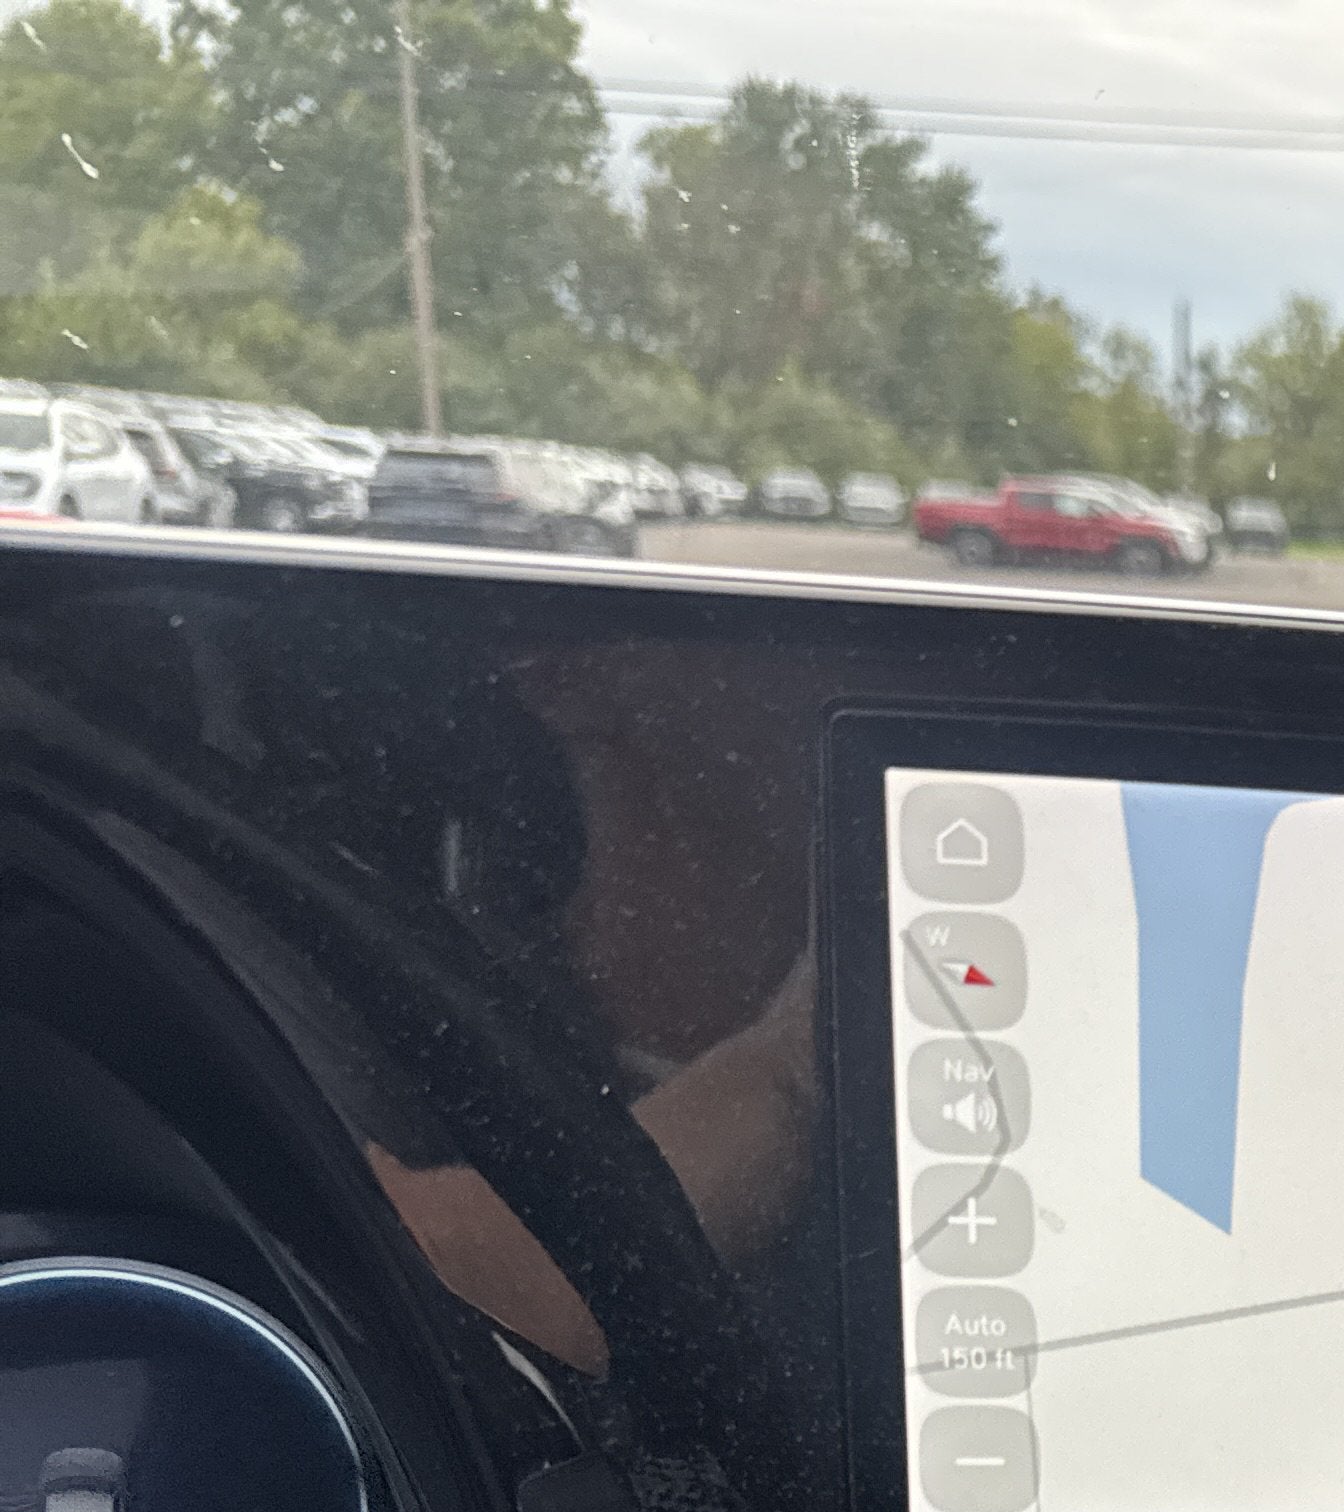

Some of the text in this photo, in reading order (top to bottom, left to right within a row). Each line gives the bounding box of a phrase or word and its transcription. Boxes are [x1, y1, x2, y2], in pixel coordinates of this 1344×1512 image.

[942, 1057, 994, 1083] Nav
[944, 1312, 1006, 1336] Auto
[940, 1346, 1016, 1371] 150 ft
